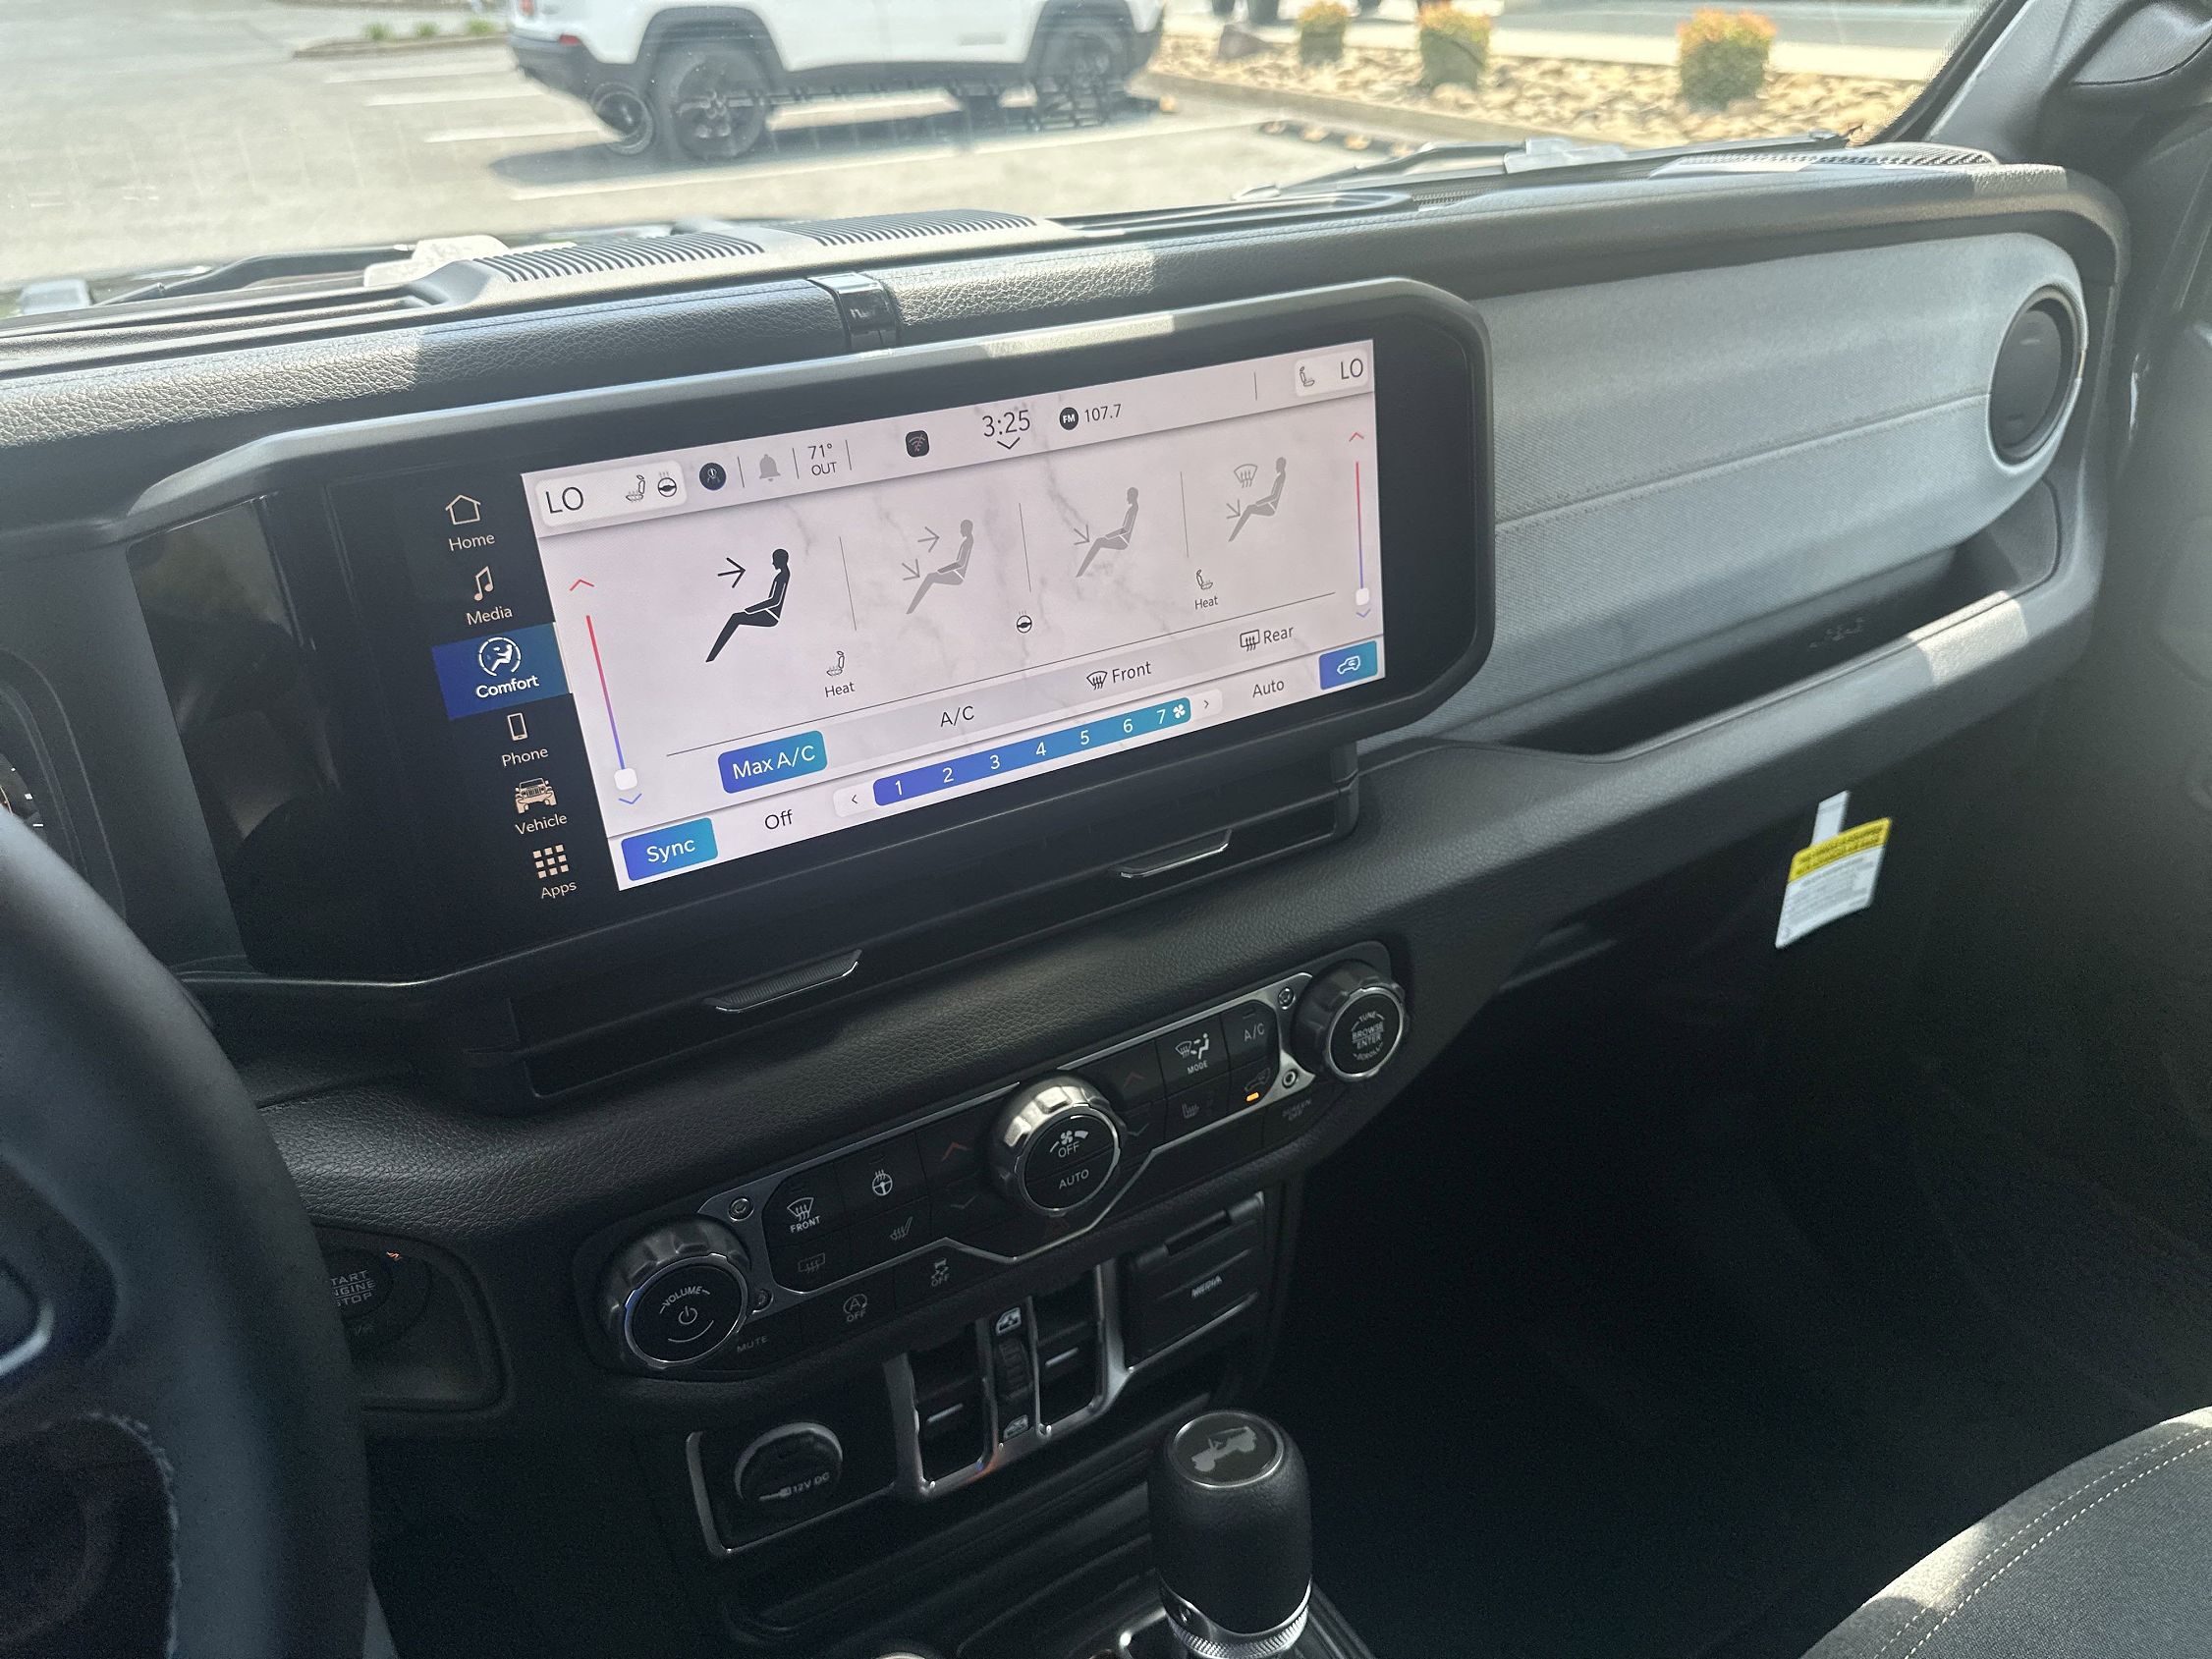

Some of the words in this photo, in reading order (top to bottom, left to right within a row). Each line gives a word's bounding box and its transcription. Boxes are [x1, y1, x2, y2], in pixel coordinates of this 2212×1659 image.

[1340, 359, 1364, 380] LO
[1062, 414, 1077, 424] FM
[1084, 404, 1123, 422] 107.7
[982, 410, 1030, 437] 3:25
[807, 443, 834, 460] 71°
[811, 461, 838, 476] OUT
[545, 485, 585, 514] LO
[448, 531, 496, 552] Home
[1194, 595, 1219, 610] Heat
[466, 605, 514, 626] Media
[1262, 625, 1295, 645] Rear
[1111, 660, 1152, 685] Front
[474, 674, 540, 699] Comfort
[824, 681, 856, 698] Heat
[1251, 678, 1286, 699] Auto
[939, 705, 975, 729] A/C
[501, 746, 550, 768] Phone
[731, 756, 775, 781] Max
[775, 744, 817, 773] A/C
[894, 780, 903, 797] 1
[942, 767, 955, 784] 2
[989, 754, 1001, 771] 3
[1034, 742, 1047, 757] 4
[1079, 730, 1090, 746] 5
[1122, 718, 1134, 734] 6
[1156, 708, 1167, 725] 7
[514, 811, 568, 835] Vehicle
[763, 808, 795, 831] Off
[645, 837, 696, 864] Sync
[539, 880, 578, 901] Apps
[1244, 1023, 1265, 1041] A/C
[1187, 1060, 1209, 1075] MODE
[1058, 1140, 1080, 1158] OFF
[1059, 1169, 1089, 1189] AUTO
[790, 1215, 821, 1233] FRONT
[330, 1270, 367, 1286] TART
[335, 1278, 376, 1297] NGINE
[931, 1273, 950, 1288] OFF
[662, 1286, 703, 1306] VOLUME
[846, 1309, 866, 1322] OFF
[737, 1336, 769, 1353] MUTE
[814, 1472, 830, 1486] DC
